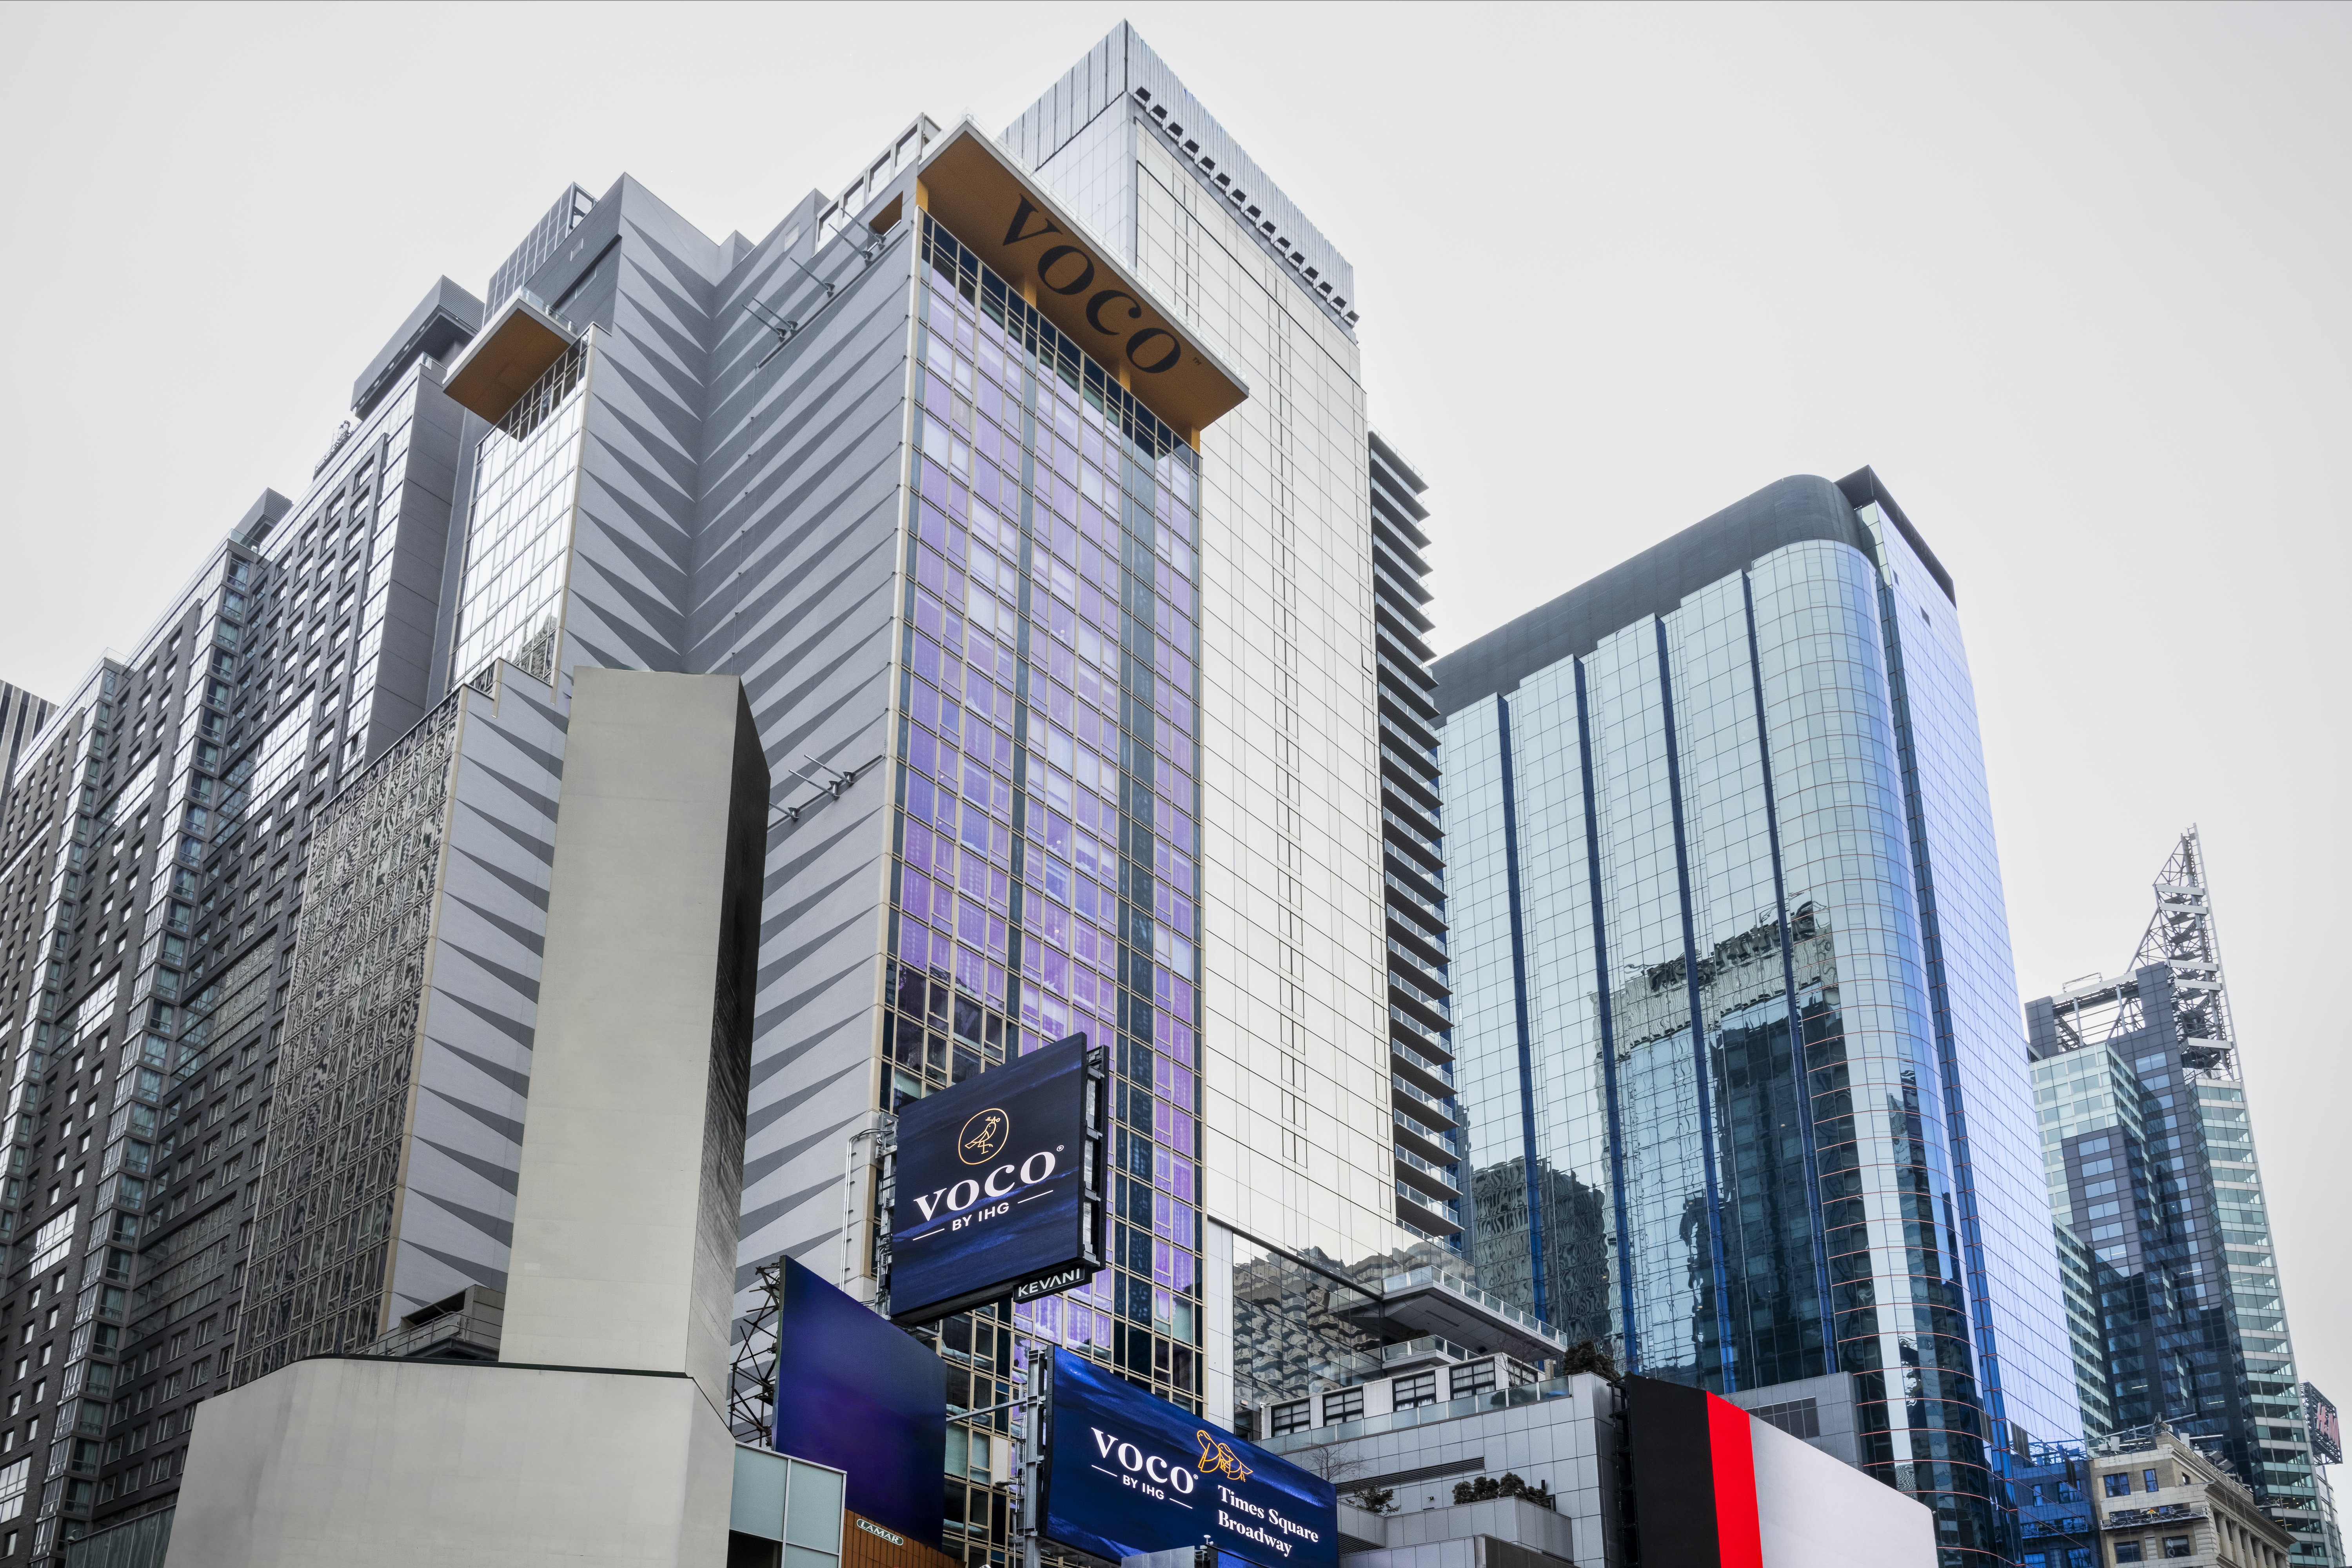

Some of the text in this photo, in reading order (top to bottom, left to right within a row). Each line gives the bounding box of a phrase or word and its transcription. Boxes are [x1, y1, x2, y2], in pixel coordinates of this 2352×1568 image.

[952, 1202, 1009, 1231] BY IHG
[1018, 1268, 1080, 1297] KEVANI
[2316, 1402, 2339, 1449] H&M
[1123, 1474, 1164, 1500] BY IHG
[1218, 1485, 1319, 1543] Times Square
[861, 1521, 899, 1543] LAMAR
[1218, 1510, 1293, 1557] Broadway
